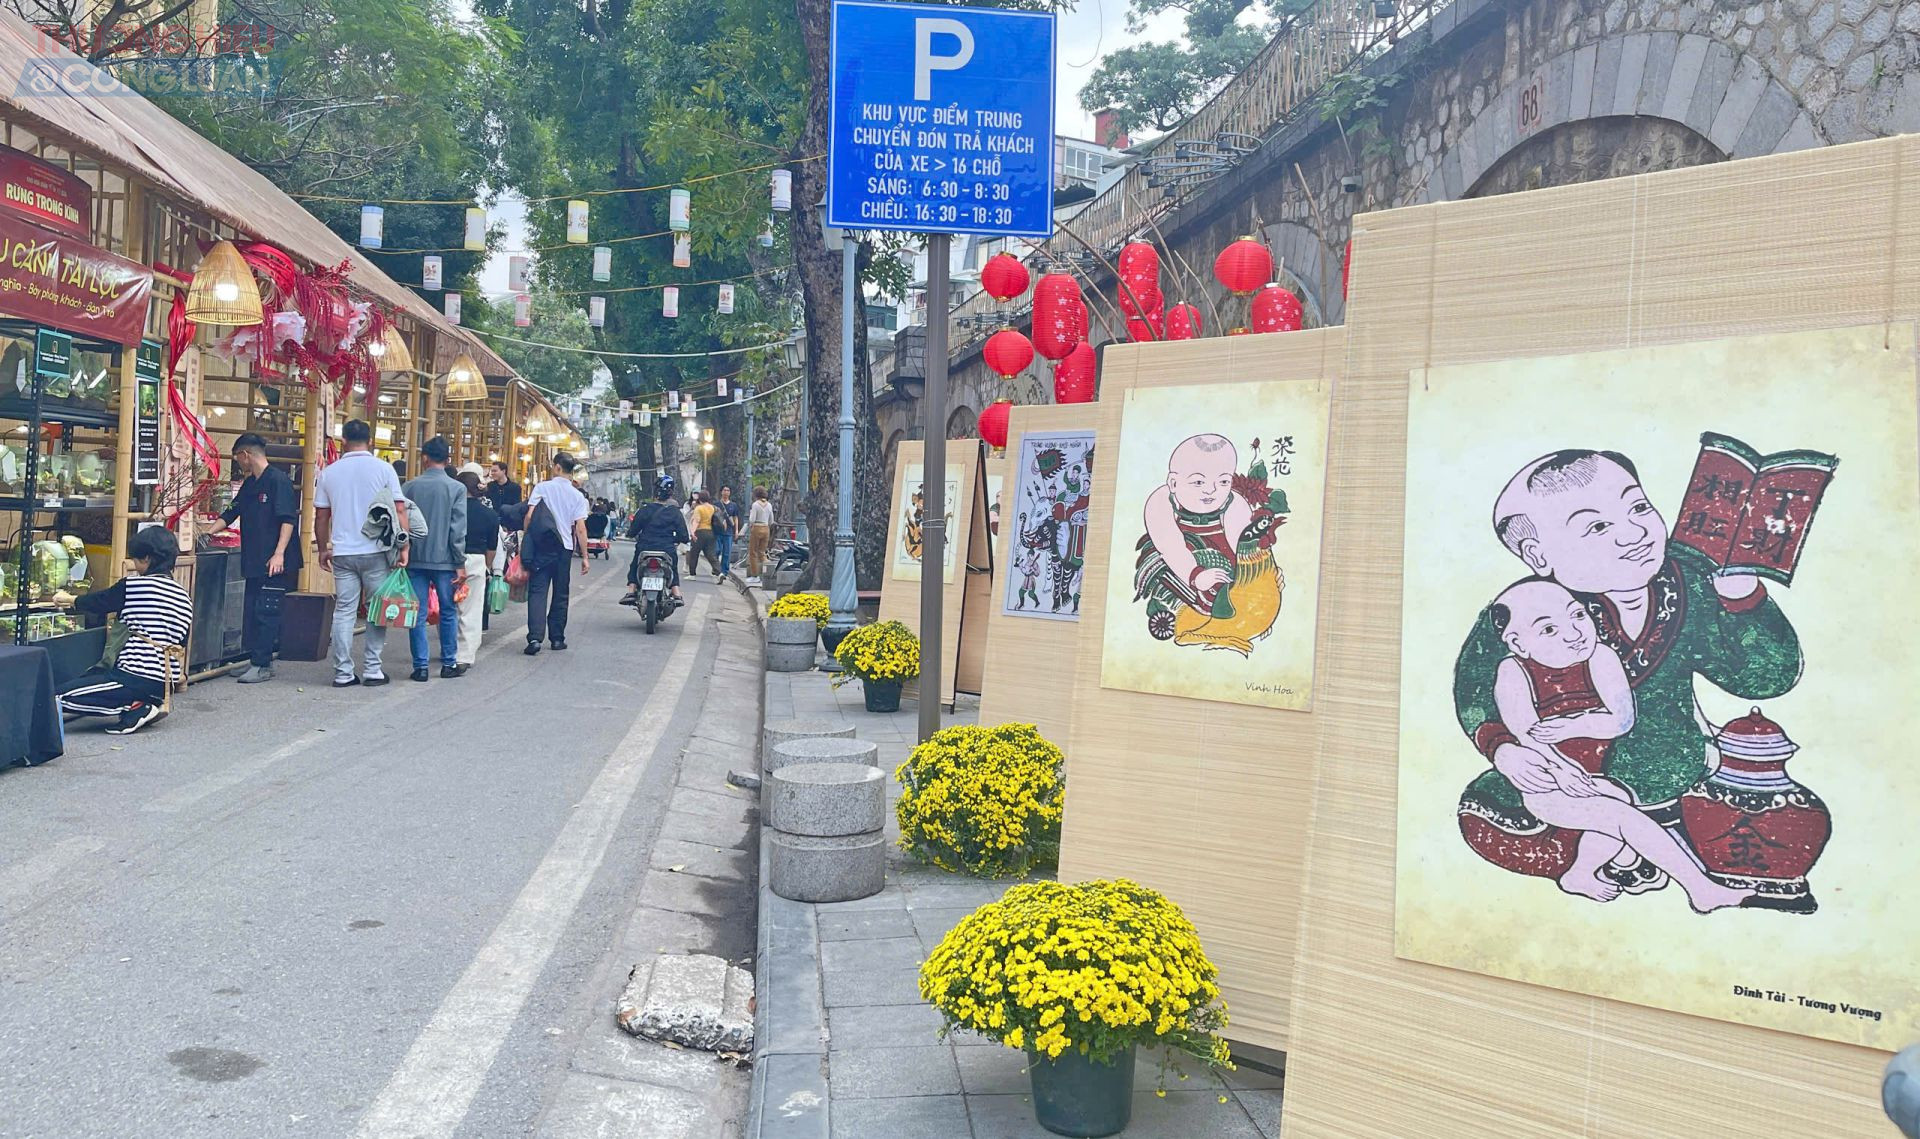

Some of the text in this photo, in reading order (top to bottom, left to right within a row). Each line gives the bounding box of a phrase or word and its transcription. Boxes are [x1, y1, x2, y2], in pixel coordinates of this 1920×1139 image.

[914, 18, 975, 101] P
[863, 102, 1022, 129] KHU VỰC ĐIỂM TRUNG
[1522, 85, 1538, 126] 68
[853, 123, 1034, 154] CHUYỂN ĐÓN TRẢ KHÁCH
[875, 148, 904, 171] CỦA
[911, 154, 929, 172] XE
[952, 157, 967, 174] 16
[973, 154, 1001, 176] CHỖ
[867, 172, 912, 195] SÁNG:
[36, 192, 64, 217] TRONG
[861, 196, 908, 219] CHIỀU:
[1246, 681, 1295, 695] Vinh Hoa
[1733, 985, 1763, 999] Đinh
[1766, 989, 1786, 1003] Tài
[1797, 996, 1836, 1013] Tương
[1840, 1003, 1882, 1021] Vượng
